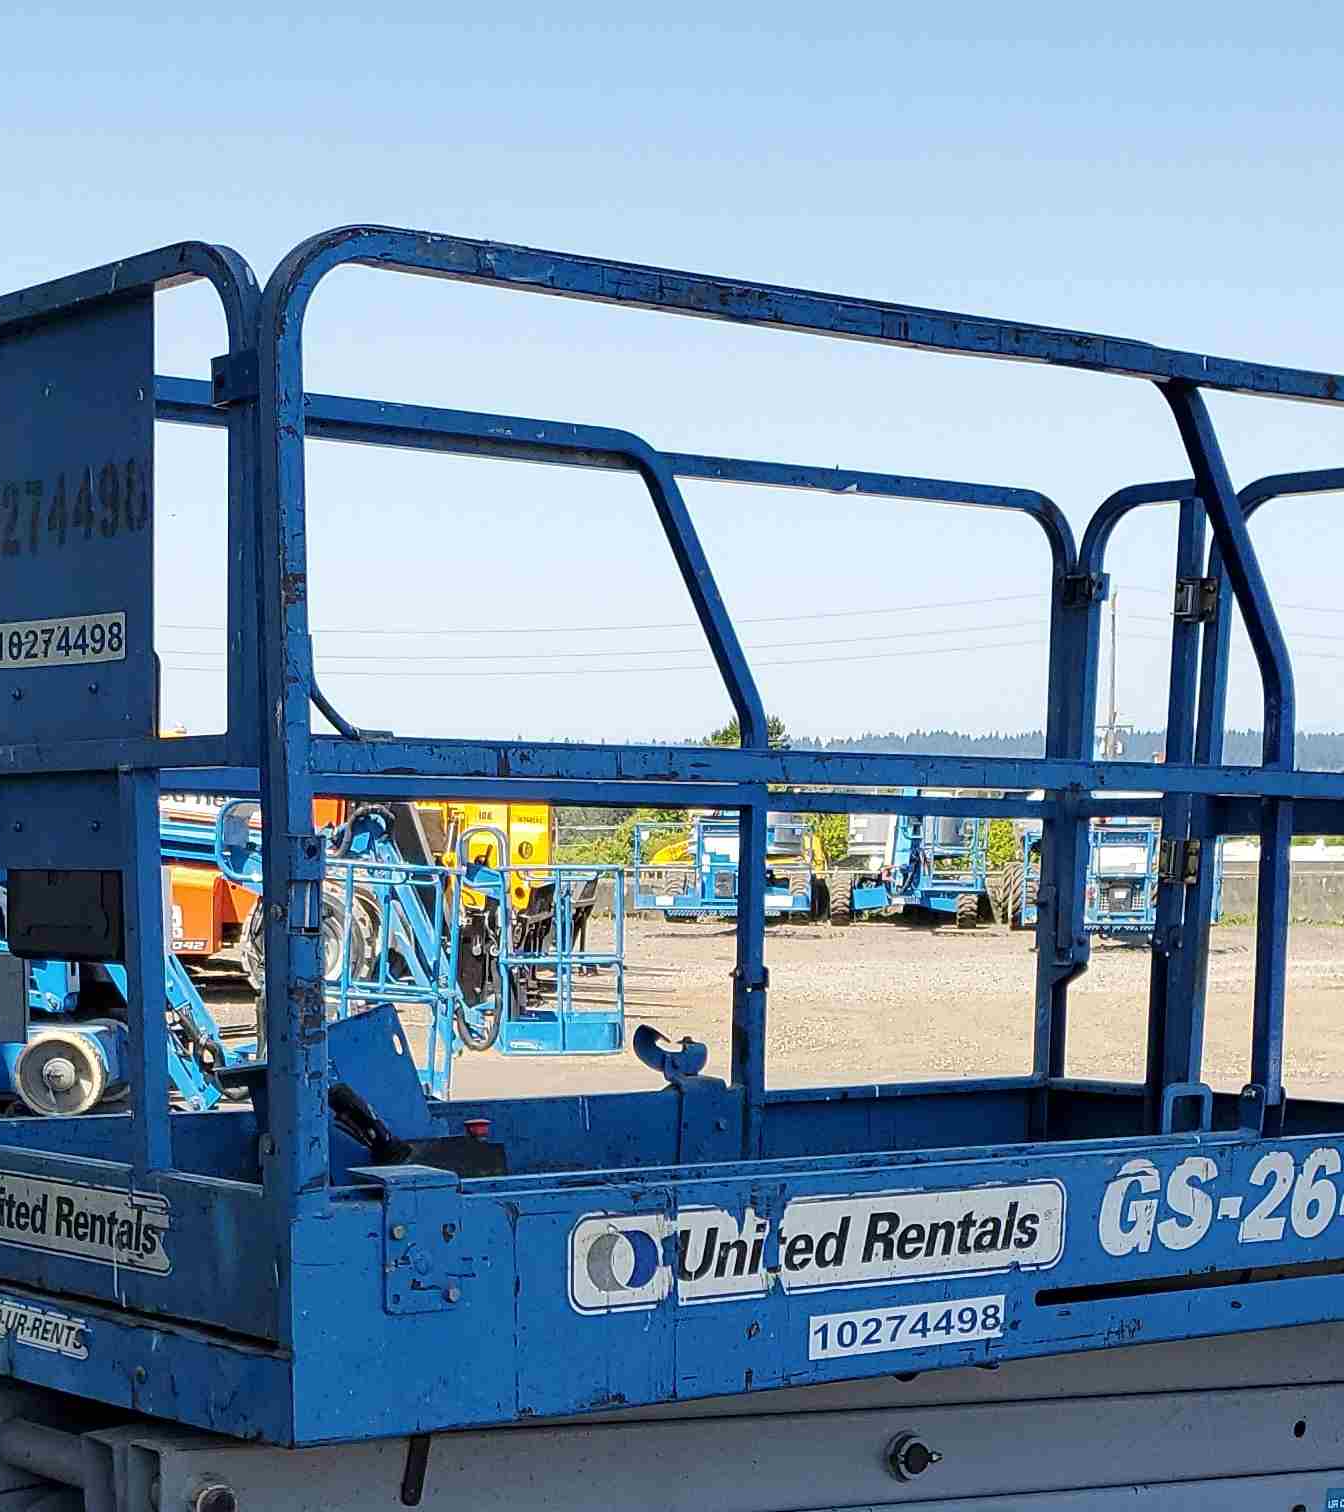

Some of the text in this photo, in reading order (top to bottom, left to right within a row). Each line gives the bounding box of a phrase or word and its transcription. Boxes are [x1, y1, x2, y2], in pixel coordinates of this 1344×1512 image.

[56, 1196, 160, 1253] Rentals
[861, 1201, 1039, 1264] Rentals
[813, 1304, 1002, 1352] 10274498
